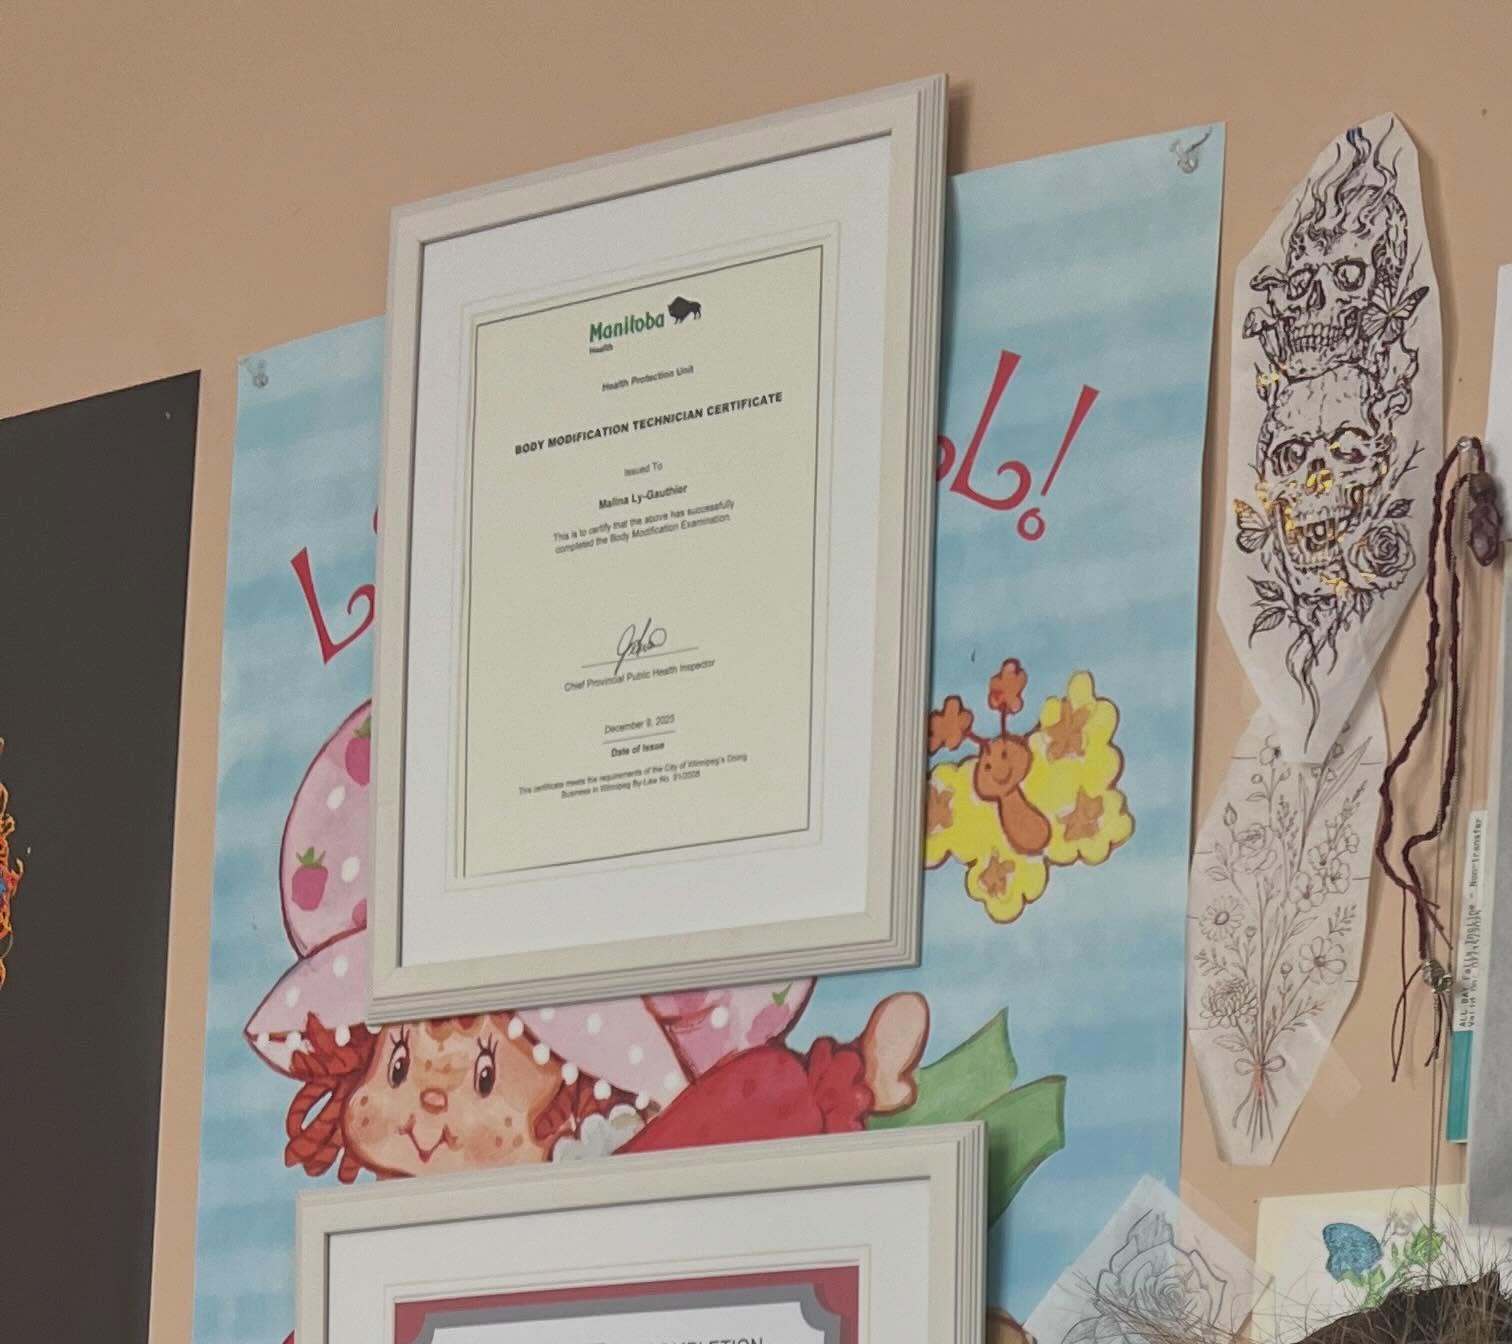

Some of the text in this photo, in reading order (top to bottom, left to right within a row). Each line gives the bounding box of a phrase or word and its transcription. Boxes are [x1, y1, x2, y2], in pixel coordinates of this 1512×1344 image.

[589, 311, 665, 342] Manitoba
[602, 365, 694, 392] Health Protection Unit
[515, 391, 784, 456] BODY MODIFICATION TECHNICIAN CERTIFICATE
[624, 461, 663, 477] Issued To
[599, 484, 688, 509] Malina Ly-Gauthier
[554, 499, 735, 542] This certify that the above has successfully
[555, 523, 679, 554] completed the Body Modification
[564, 659, 715, 692] Chief Provincial Public Health Inspector
[604, 720, 644, 735] December
[611, 741, 665, 758] Date of Issue
